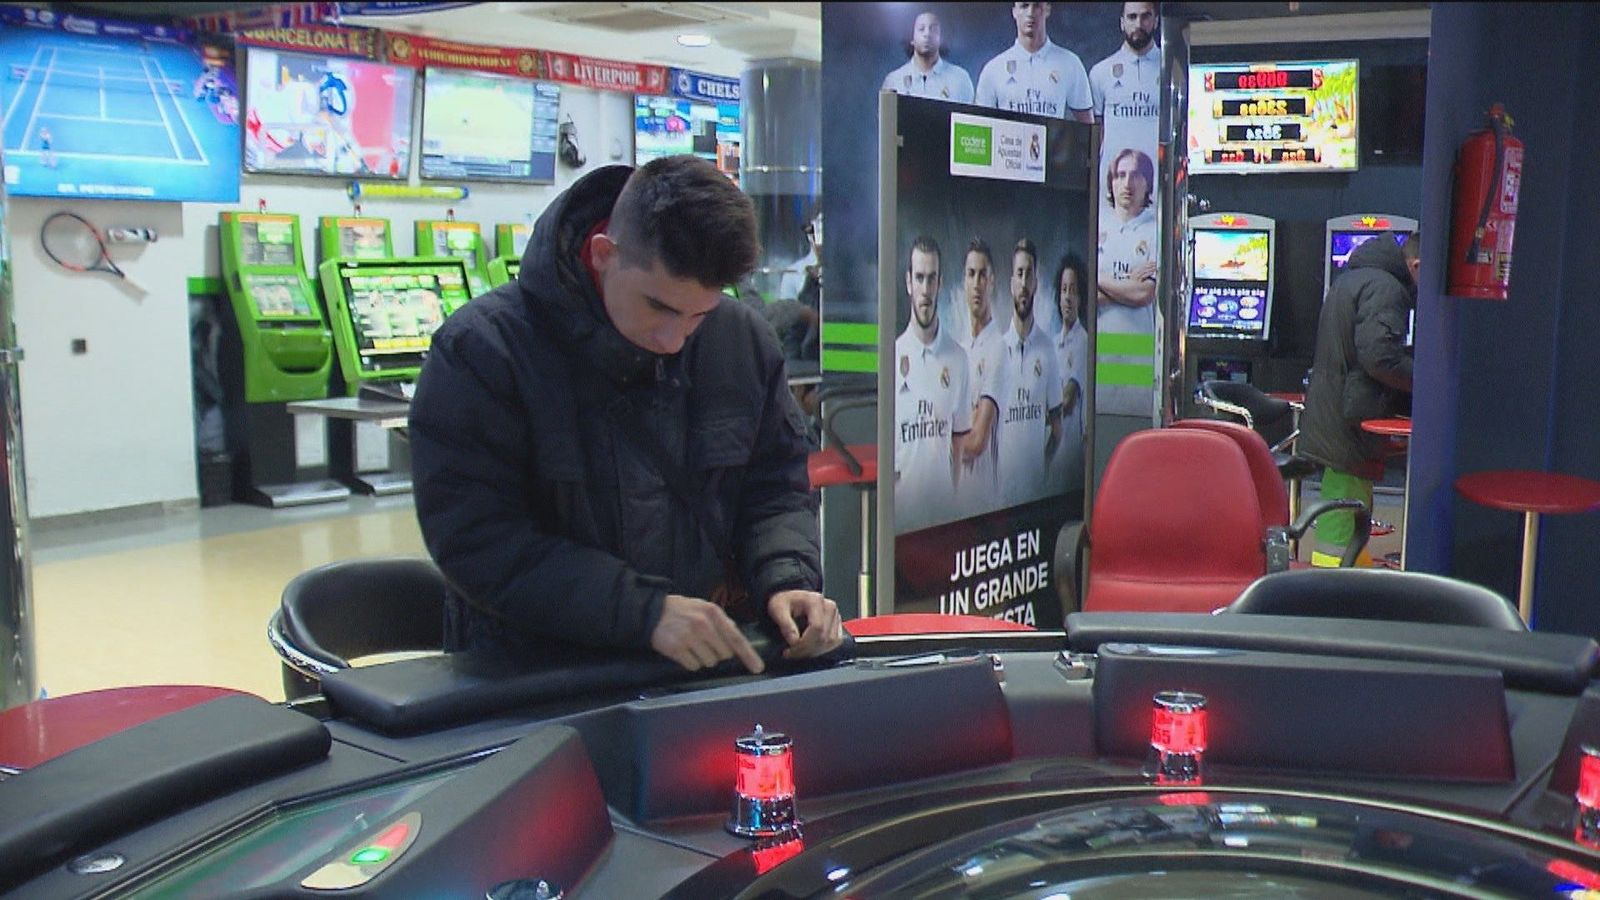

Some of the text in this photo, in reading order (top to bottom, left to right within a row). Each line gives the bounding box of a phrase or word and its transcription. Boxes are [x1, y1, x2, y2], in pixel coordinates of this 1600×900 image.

[573, 62, 641, 87] LIVERPOOL
[697, 79, 740, 99] CHELS
[1132, 91, 1150, 103] Fly
[1009, 100, 1057, 116] Emirates
[918, 399, 934, 417] Fly
[950, 528, 1041, 582] JUEGA EN
[939, 561, 1049, 616] UN GRANDE
